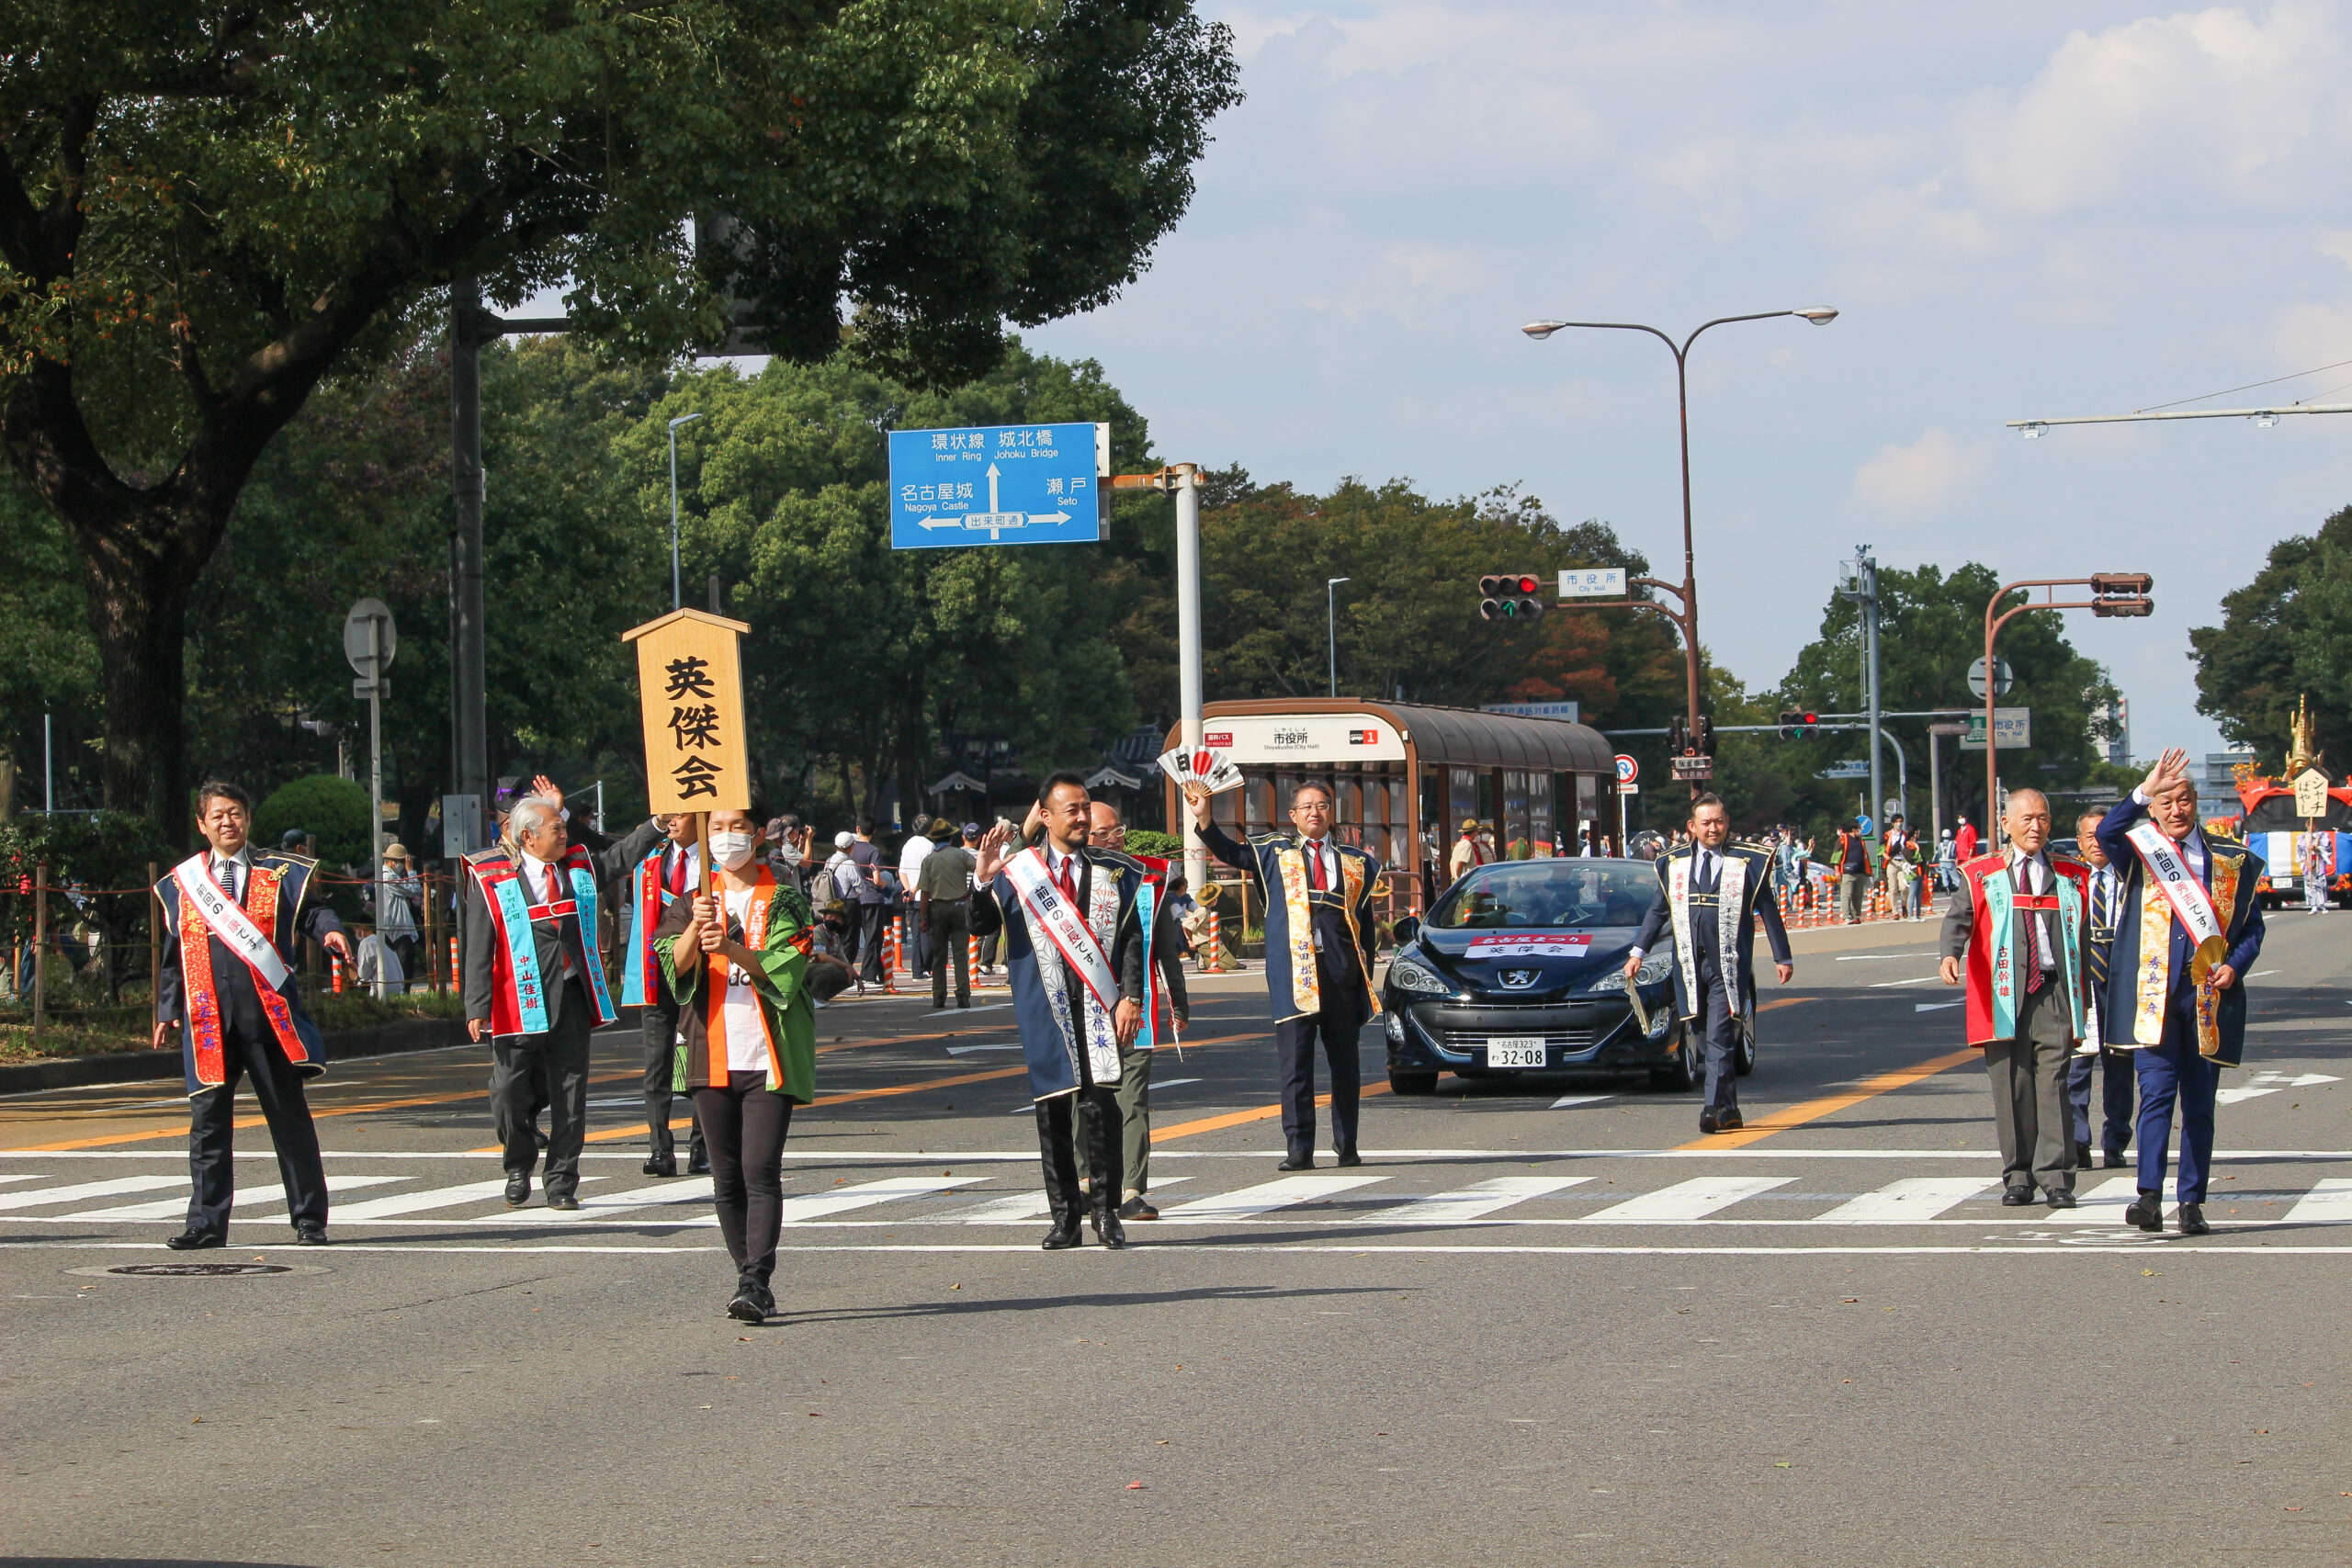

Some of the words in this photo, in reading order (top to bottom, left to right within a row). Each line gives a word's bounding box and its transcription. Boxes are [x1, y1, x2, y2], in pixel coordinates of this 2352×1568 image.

[932, 433, 985, 450] 環状線
[999, 429, 1054, 448] 城北橋
[935, 452, 956, 462] Inner
[962, 451, 982, 462] Ring
[994, 449, 1026, 460] Johoku
[1031, 448, 1058, 458] Bridge
[900, 482, 974, 502] 名古屋城
[1046, 477, 1087, 495] 瀬戸
[904, 502, 937, 513] Nagoya
[942, 502, 969, 511] Castle
[1057, 496, 1078, 506] Seto
[970, 514, 1019, 526] 出来町通
[1567, 573, 1617, 585] 市役所
[665, 656, 724, 800] 英傑会
[1995, 719, 2025, 730] 市役所
[1274, 732, 1308, 744] 市役所
[1367, 732, 1374, 742] 1
[2311, 777, 2324, 815] シャチ
[2154, 847, 2212, 931] 前回の秀吉です。
[1035, 886, 1101, 968] 前回の信長です。
[1481, 936, 1580, 944] 名古屋まつり
[1489, 945, 1566, 953] 英傑会
[519, 955, 537, 1009] 中山佳樹
[1501, 1050, 1543, 1065] 32-08
